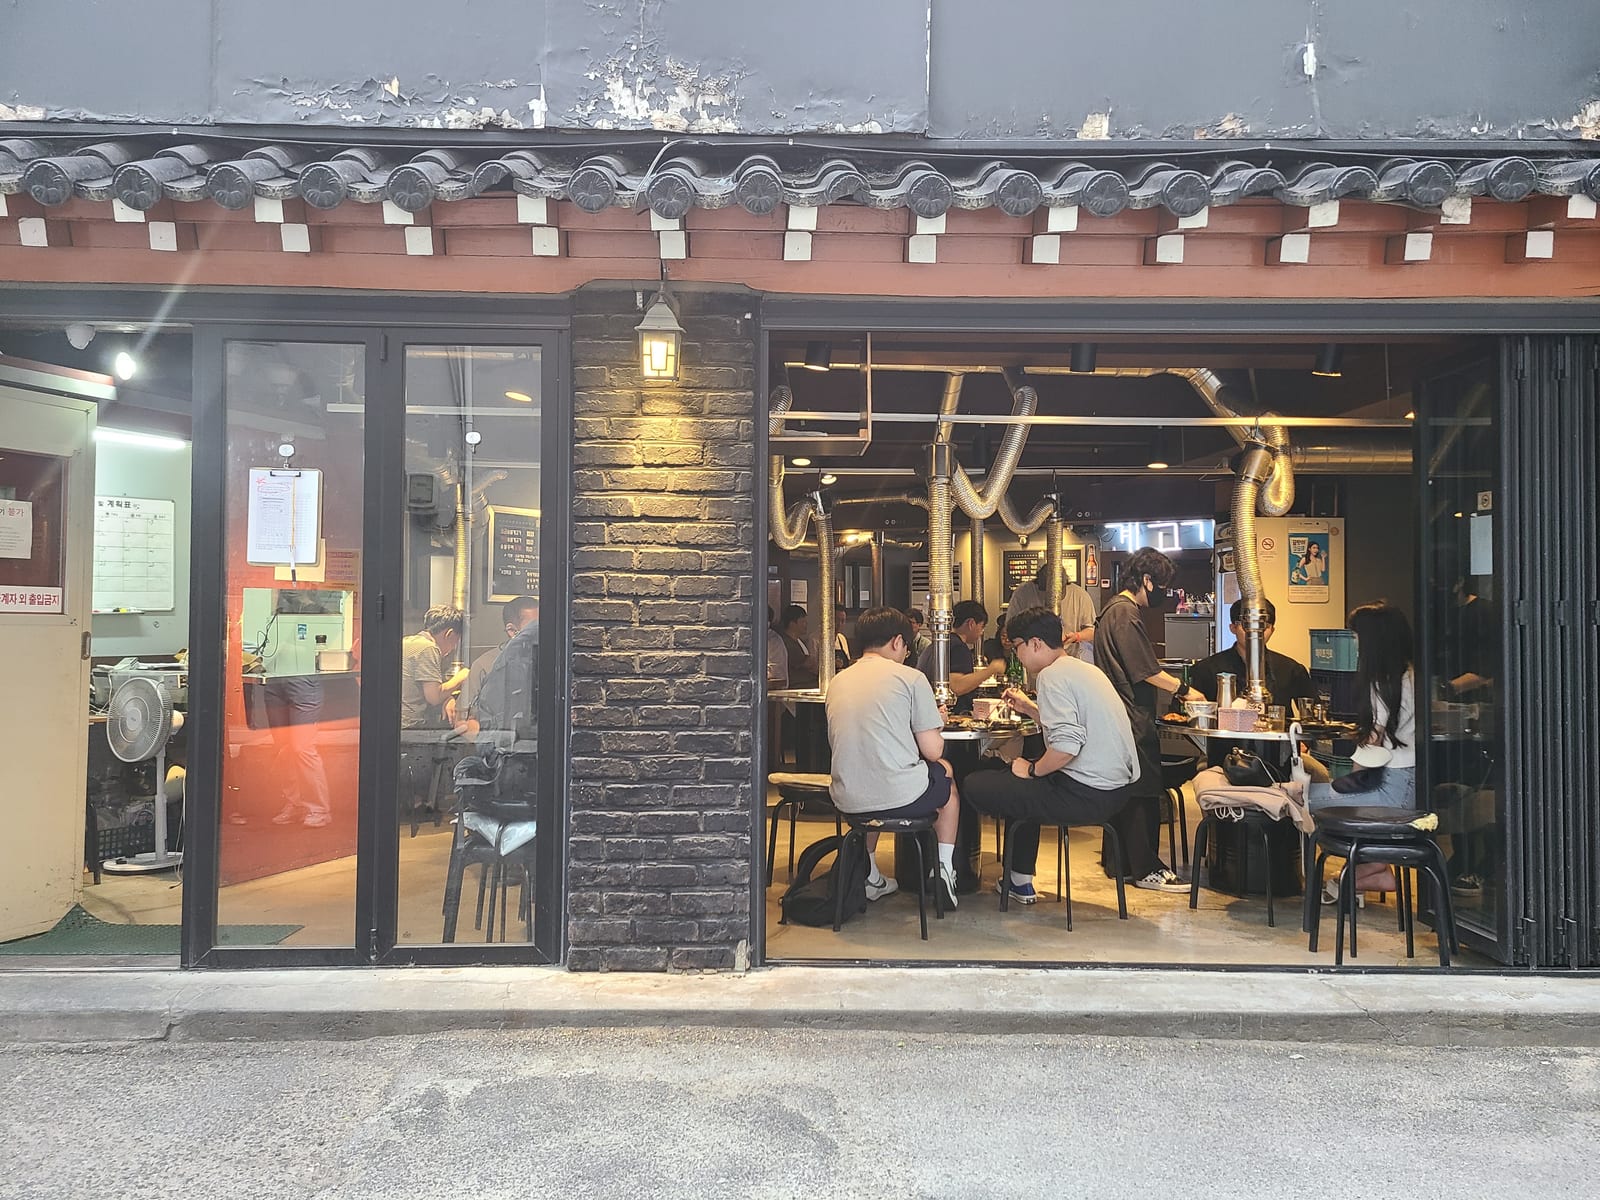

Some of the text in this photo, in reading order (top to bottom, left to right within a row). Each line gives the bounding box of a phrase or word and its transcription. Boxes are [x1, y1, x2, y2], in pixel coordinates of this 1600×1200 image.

[107, 500, 131, 509] 계획표
[8, 507, 25, 517] 불가
[0, 592, 60, 606] 계자 외 출입금지
